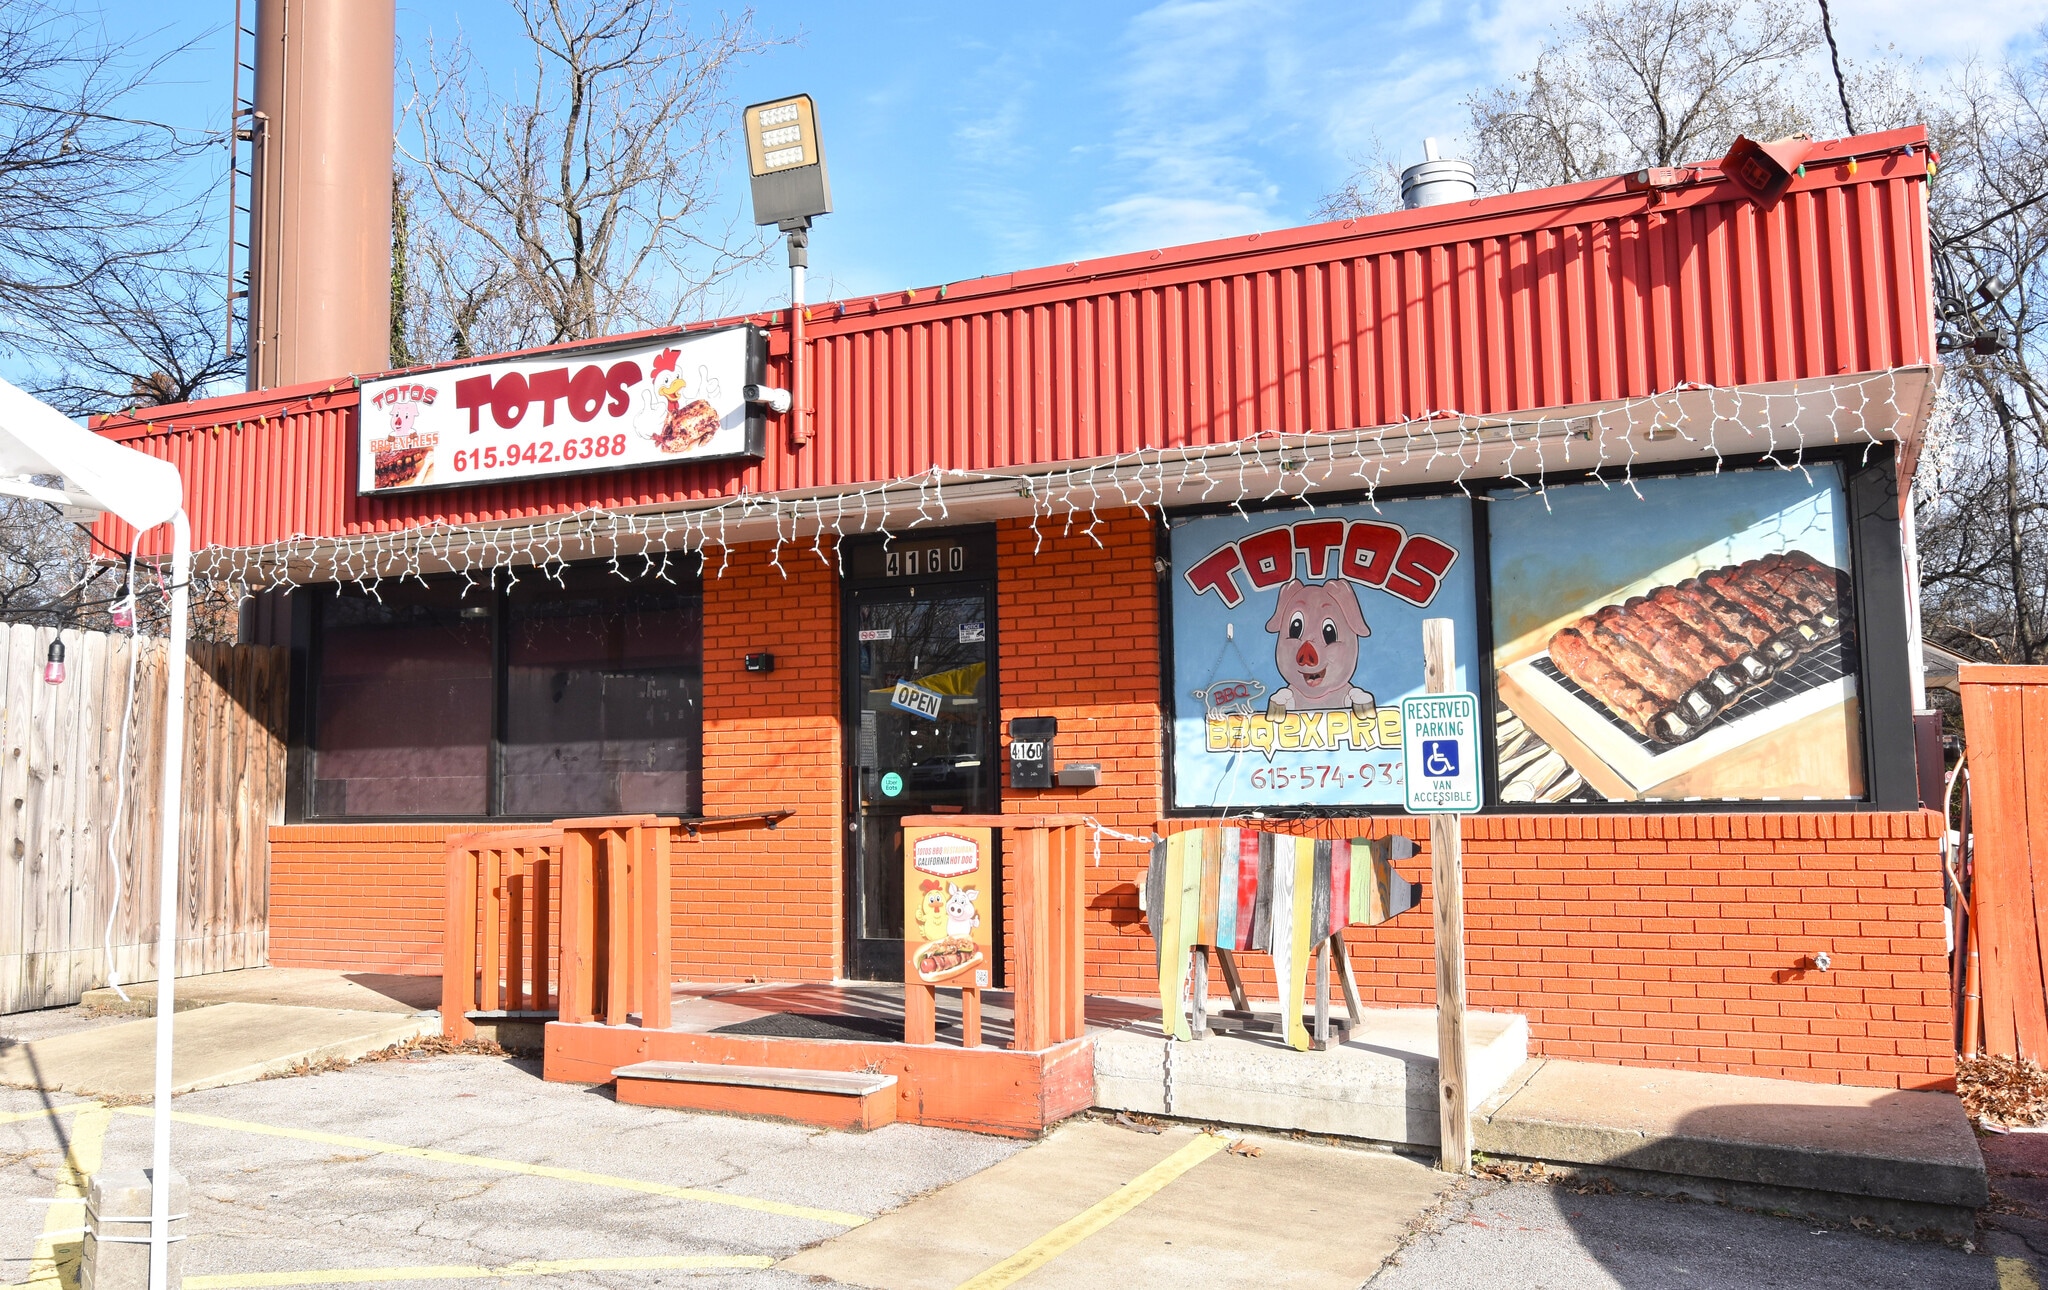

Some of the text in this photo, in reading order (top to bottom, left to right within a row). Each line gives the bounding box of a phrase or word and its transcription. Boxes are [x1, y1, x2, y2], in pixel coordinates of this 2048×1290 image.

[371, 384, 438, 410] TOTOS
[456, 361, 643, 434] TOTOS
[393, 433, 439, 450] EXPRESS
[453, 434, 627, 472] 615.942.6388
[888, 547, 961, 576] 4160
[1184, 518, 1459, 608] TOTOS
[898, 687, 938, 715] OPEN
[1214, 684, 1250, 705] BBQ
[1407, 701, 1470, 720] RESERVED
[1415, 721, 1464, 737] PARKING
[1012, 743, 1042, 759] 4160
[1251, 763, 1404, 790] 615-574-932
[1433, 780, 1452, 790] VAN
[1414, 791, 1472, 802] ACCESSIBLE
[917, 855, 973, 867] CALIFORNIA HOT DOG
